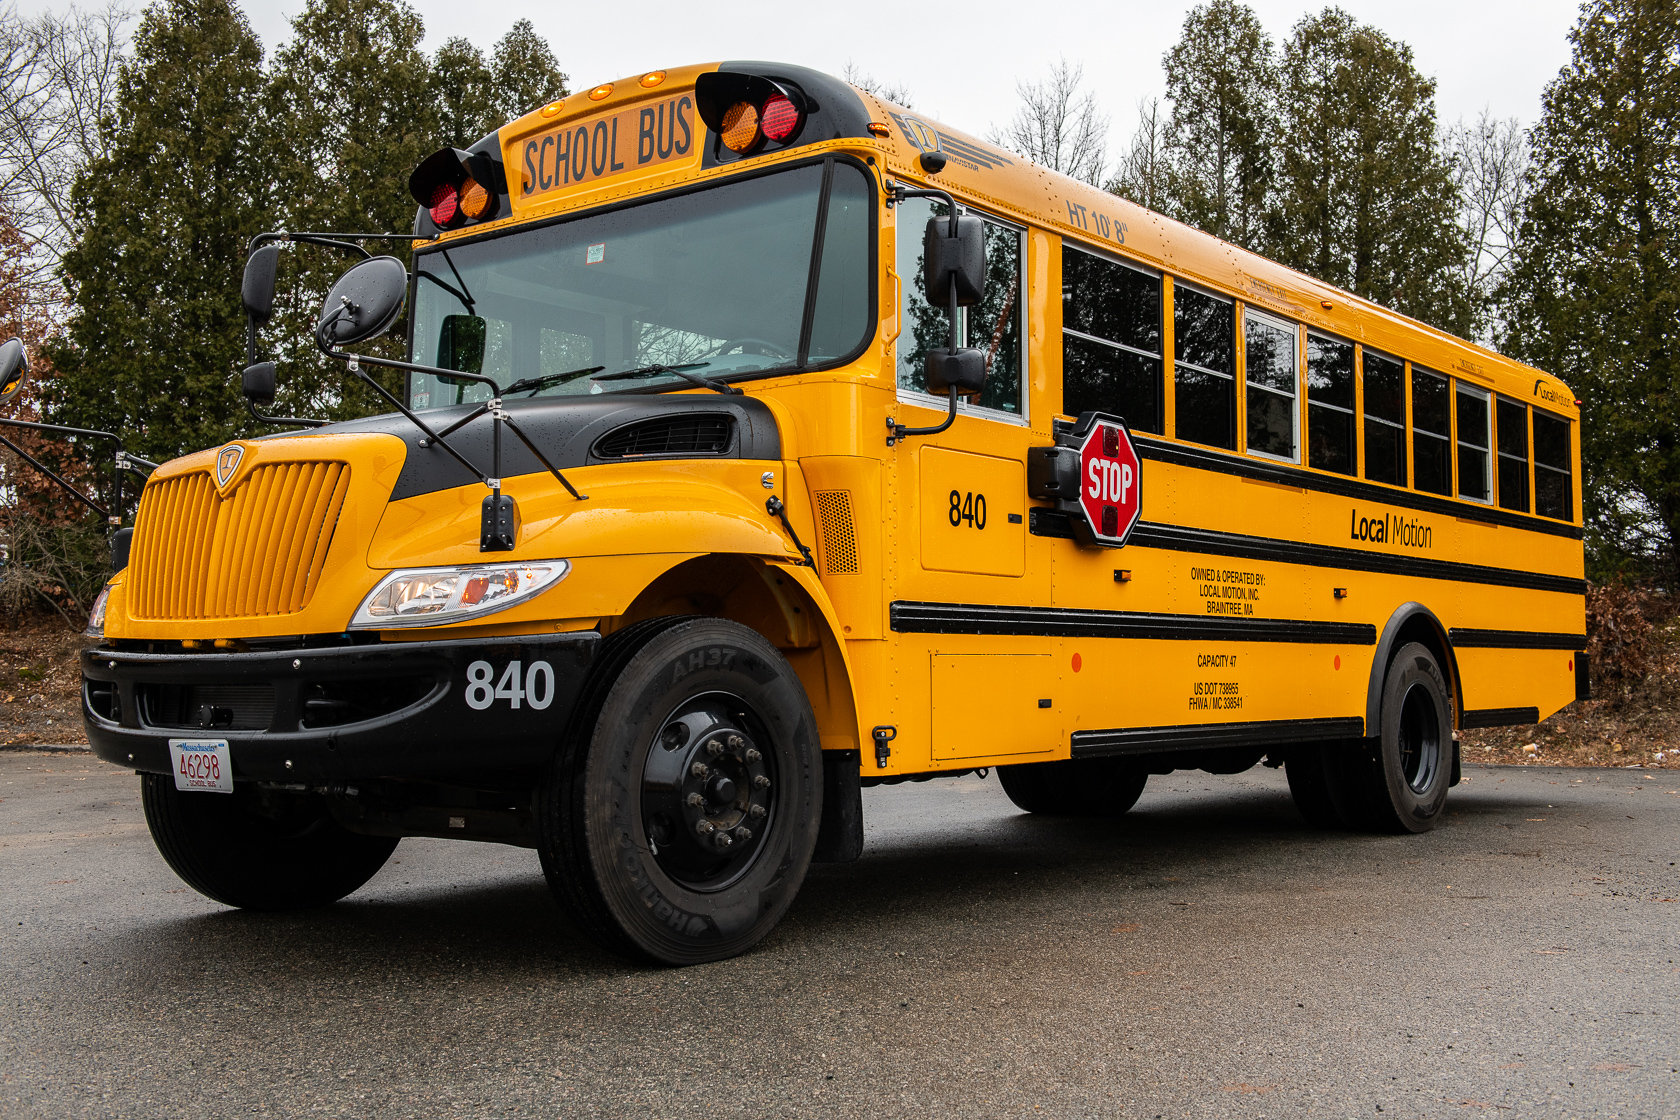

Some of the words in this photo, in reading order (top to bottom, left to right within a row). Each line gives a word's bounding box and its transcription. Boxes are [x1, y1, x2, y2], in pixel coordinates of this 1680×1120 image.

[523, 117, 624, 195] SCHOOL
[638, 96, 692, 165] BUS
[1065, 199, 1088, 230] HT
[1091, 211, 1111, 239] 10'
[1088, 457, 1133, 504] STOP
[949, 489, 987, 531] 840
[1350, 508, 1390, 544] Local
[1392, 515, 1432, 549] Motion
[1190, 566, 1216, 582] OWNED
[1216, 569, 1222, 582] &
[1222, 570, 1255, 585] OPERATED
[1255, 573, 1266, 586] BY:
[1199, 583, 1221, 598] LOCAL
[1221, 586, 1248, 602] MOTION,
[1248, 588, 1260, 601] INC.
[1206, 600, 1243, 617] BRAINTREE,
[1243, 603, 1254, 616] MA
[1197, 654, 1229, 668] CAPACITY
[1229, 655, 1237, 668] 47
[464, 659, 555, 711] 840
[1193, 682, 1204, 695] US
[1204, 681, 1218, 695] DOT
[1218, 682, 1239, 695] 738955
[1188, 697, 1208, 710] FHWA
[1212, 696, 1222, 710] MC
[1223, 696, 1243, 710] 338541
[180, 753, 220, 780] 46298
[189, 779, 207, 787] SCHOOL
[207, 779, 217, 788] BUS
